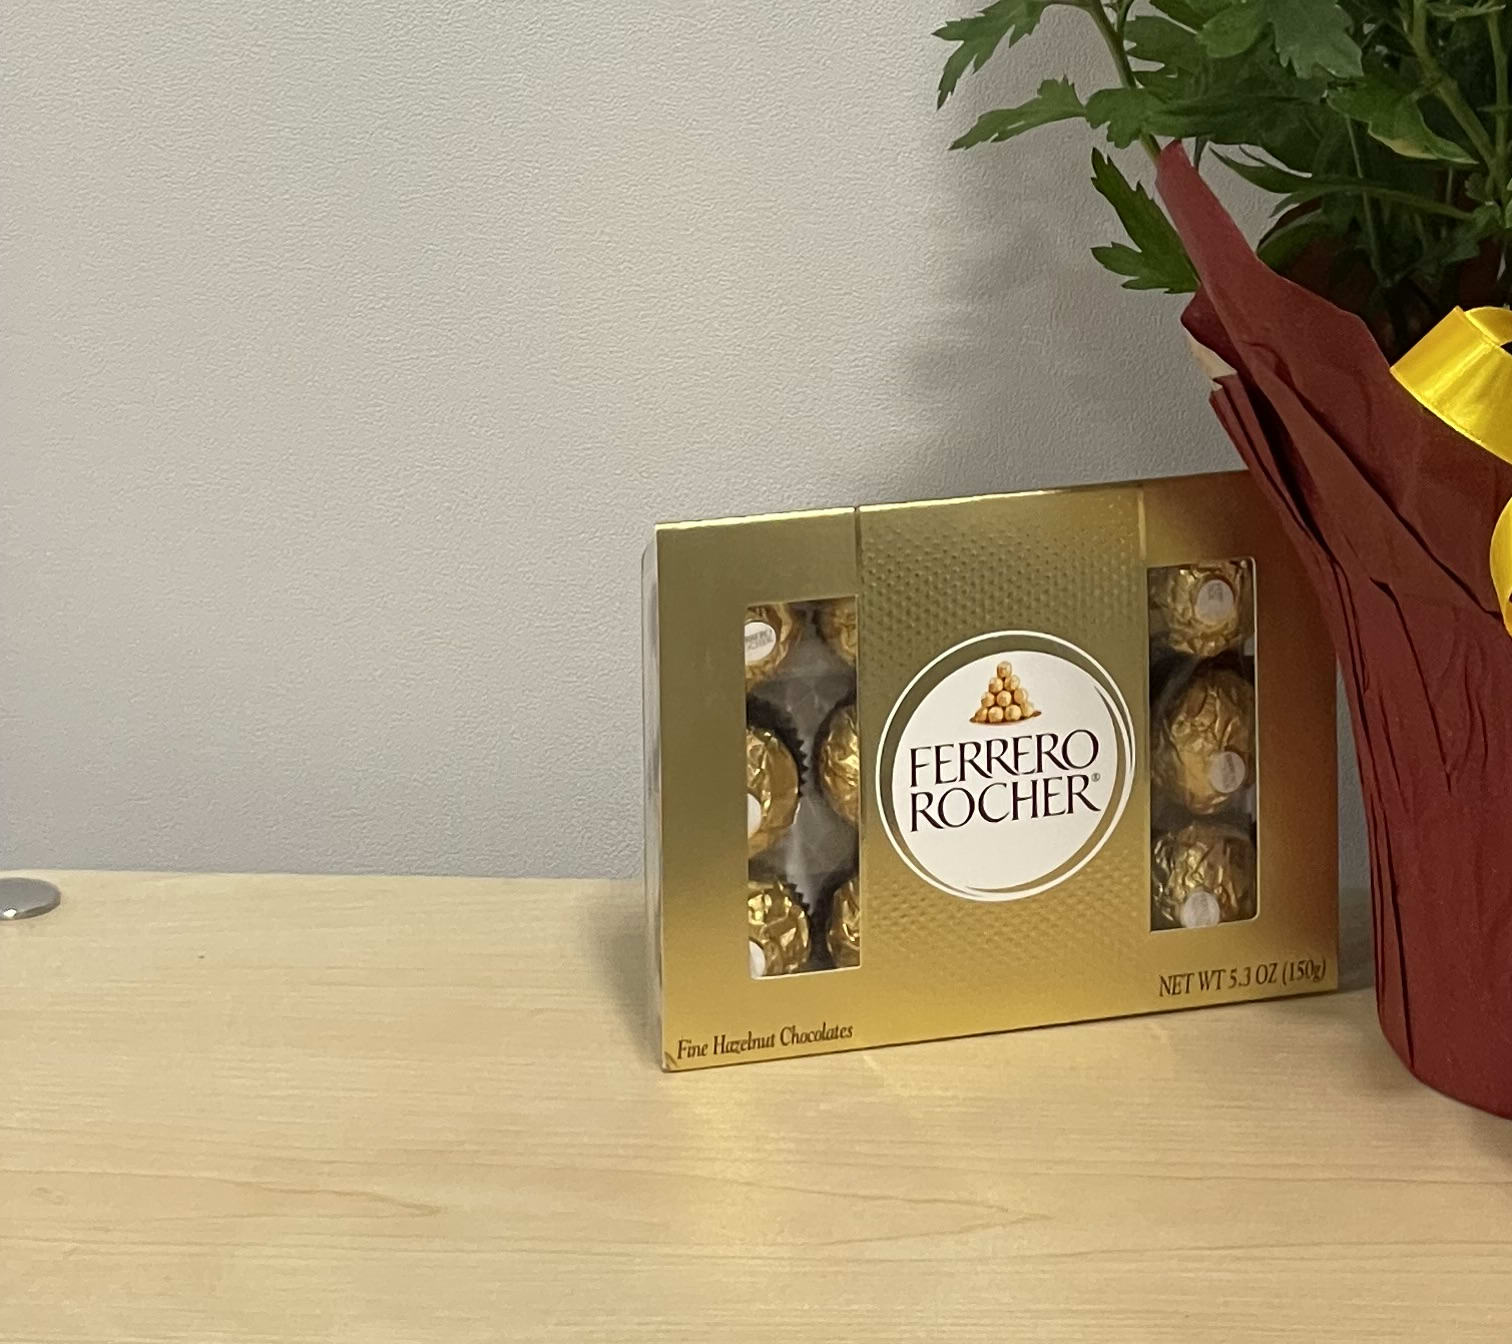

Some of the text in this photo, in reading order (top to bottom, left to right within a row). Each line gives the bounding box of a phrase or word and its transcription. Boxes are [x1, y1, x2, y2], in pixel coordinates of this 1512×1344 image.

[909, 729, 1099, 787] FERRERO
[1159, 956, 1327, 997] NET WT 5.3 OZ (150g)
[677, 1021, 853, 1060] Fine Hazelnut Chocolates
